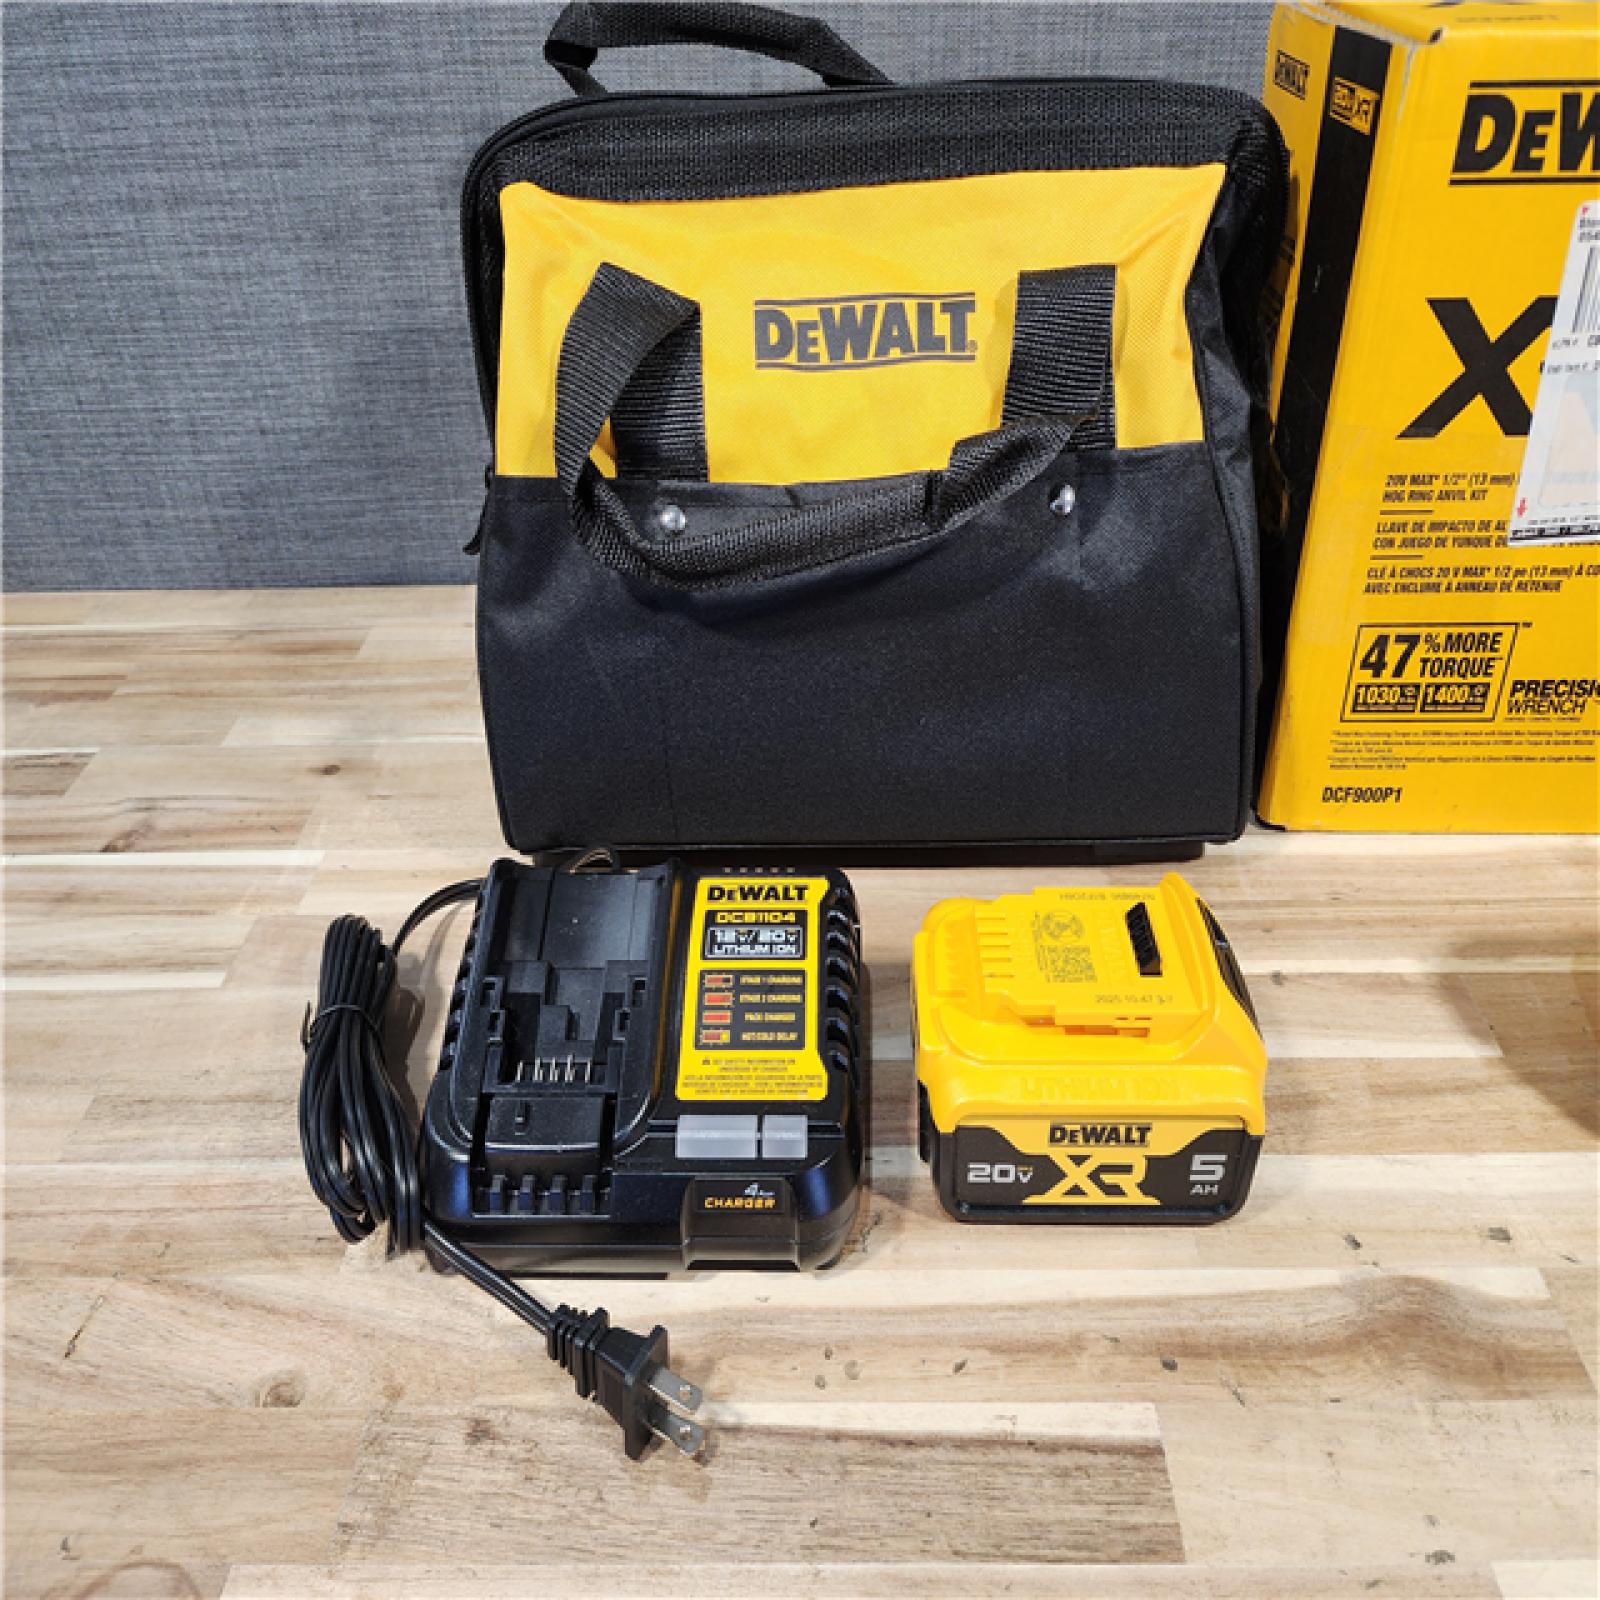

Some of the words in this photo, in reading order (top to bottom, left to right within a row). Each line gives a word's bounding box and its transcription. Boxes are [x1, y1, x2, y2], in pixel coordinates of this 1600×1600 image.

[754, 300, 976, 363] DEWALT
[1407, 490, 1434, 502] RING
[1436, 489, 1467, 502] ANVIL
[1469, 489, 1489, 501] KIT
[1411, 520, 1425, 533] DE
[1428, 520, 1476, 533] IMPACTO
[1477, 520, 1494, 533] DE
[1434, 537, 1449, 549] DE
[1498, 580, 1514, 593] DE
[1359, 634, 1422, 679] 47
[1419, 657, 1496, 680] TORQUE
[1506, 699, 1588, 716] WRENCH
[1321, 786, 1404, 804] DCF900P1
[707, 886, 809, 902] DEWALT
[1049, 1124, 1152, 1146] DEWALT
[1189, 1153, 1229, 1182] 5
[1023, 1153, 1162, 1206] XR
[1190, 1184, 1219, 1196] AH
[704, 1196, 776, 1209] CHARGER
